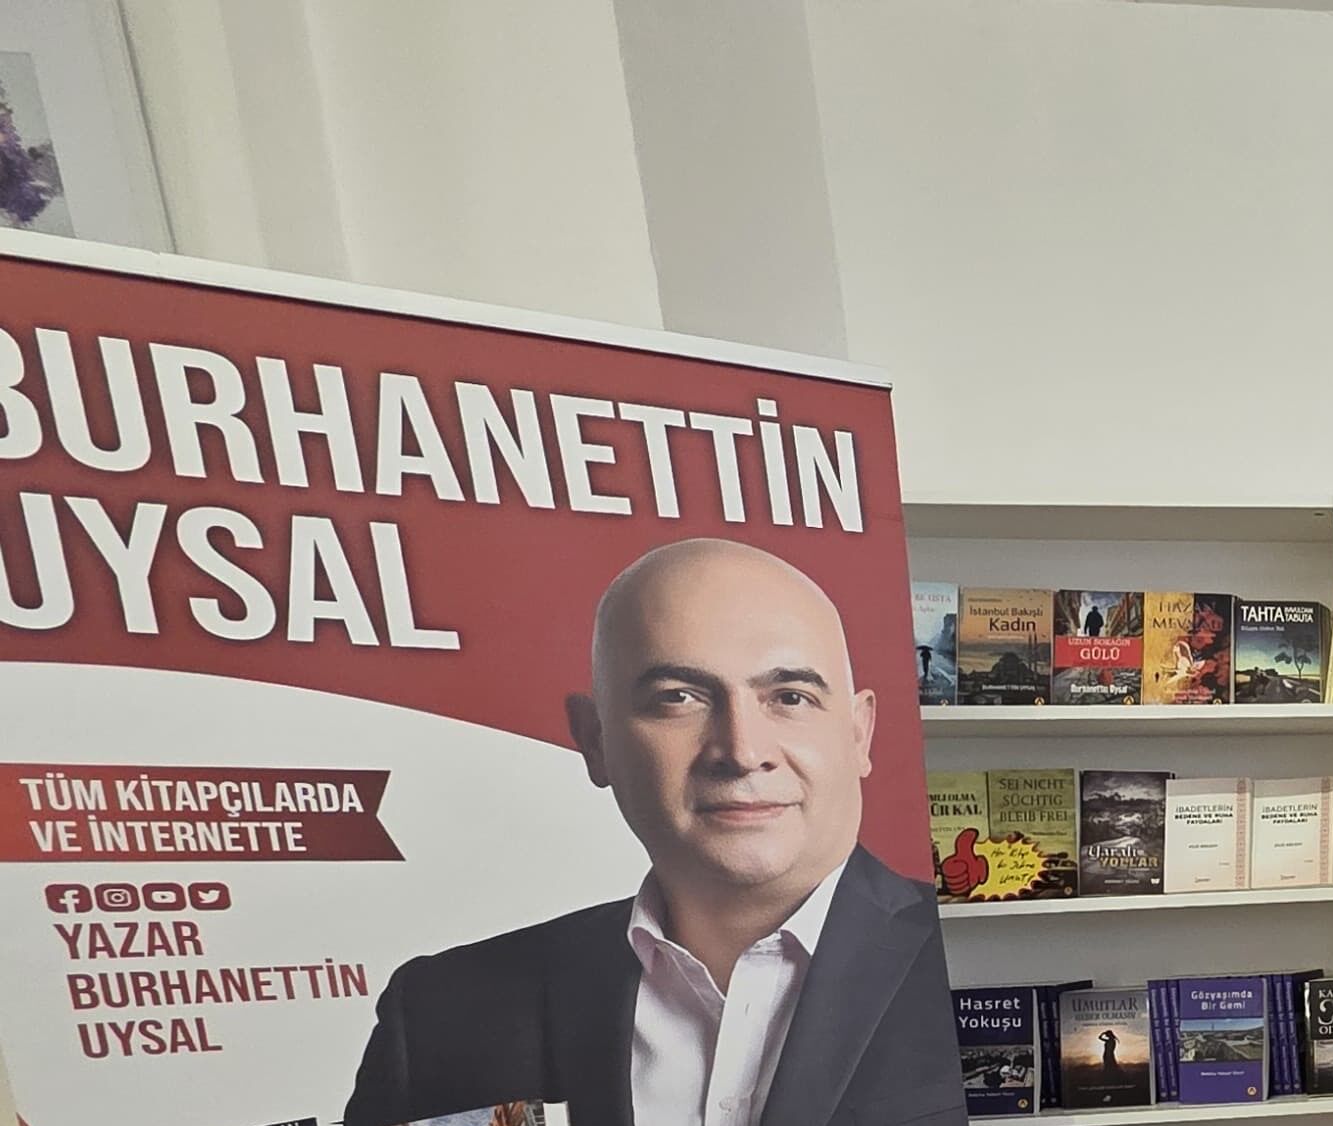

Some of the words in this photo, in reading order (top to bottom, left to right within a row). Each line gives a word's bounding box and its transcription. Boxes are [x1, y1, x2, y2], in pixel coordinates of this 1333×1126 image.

[0, 490, 460, 651] UYSAL
[1241, 605, 1285, 622] TAHTA
[989, 617, 1036, 632] Kadın
[1080, 647, 1120, 660] GÜLÜ
[999, 778, 1020, 789] SEI
[1023, 777, 1065, 789] NICHT
[19, 772, 107, 812] TÜM
[115, 774, 364, 817] KİTAPÇILARDA
[1003, 793, 1063, 806] SÜCHTIG
[1000, 810, 1036, 823] BLEIB
[1040, 810, 1068, 822] FREI
[29, 820, 82, 852] VE
[87, 815, 307, 852] İNTERNETTE
[53, 921, 204, 959] YAZAR
[66, 957, 369, 1011] BURHANETTİN
[1191, 989, 1253, 1002] Gözyaşımda
[960, 997, 1021, 1011] Hasret
[1201, 1001, 1216, 1010] Bir
[1219, 1001, 1246, 1010] Gemi
[959, 1015, 1022, 1032] Yokuşu
[77, 1017, 223, 1059] UYSAL
